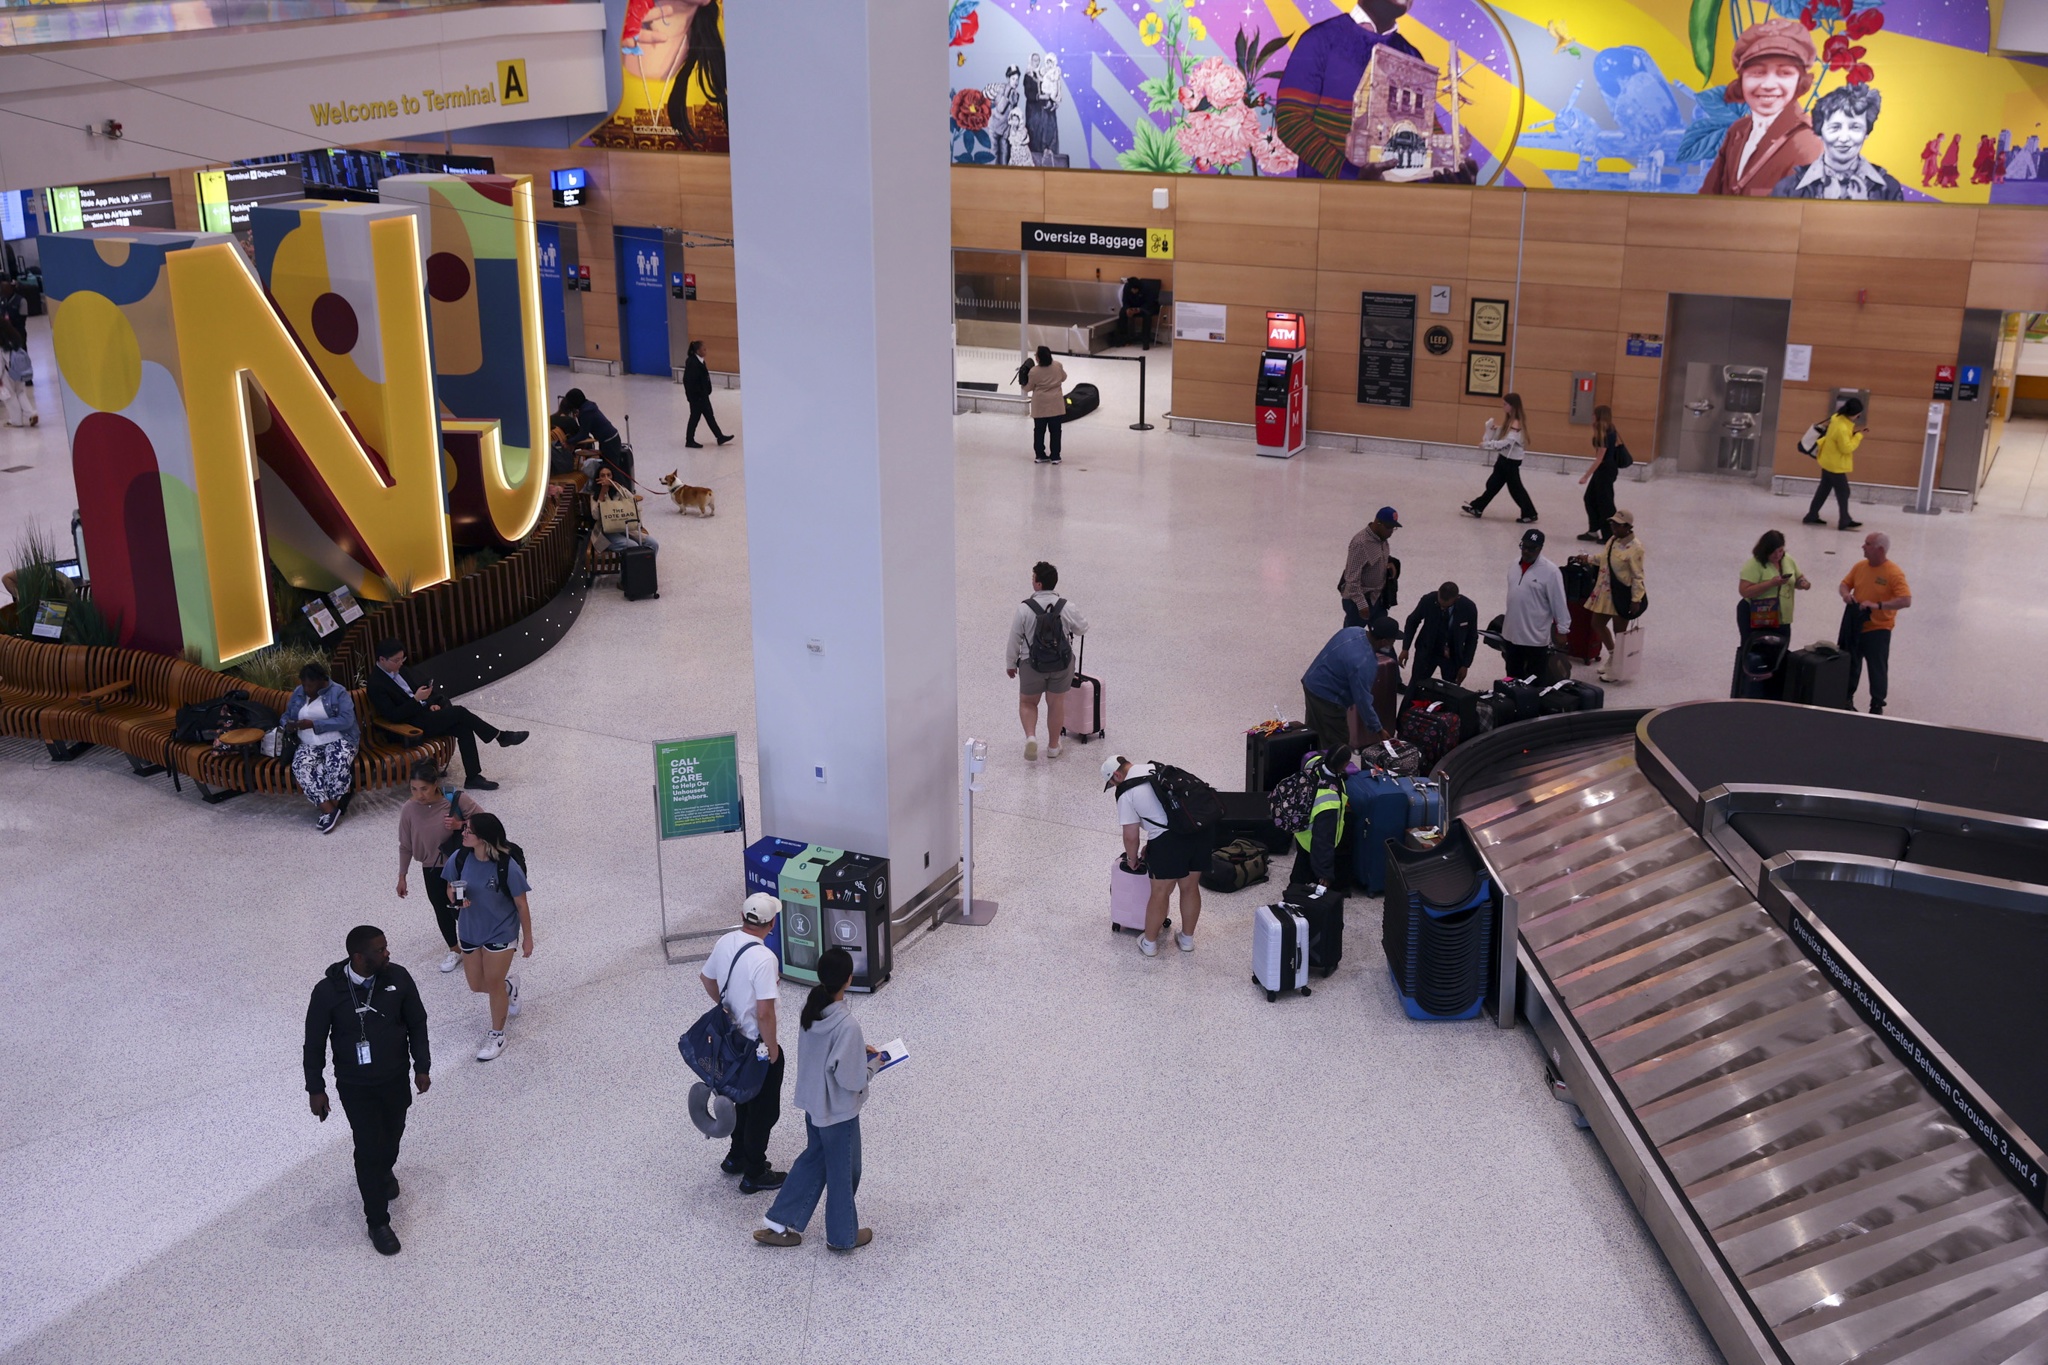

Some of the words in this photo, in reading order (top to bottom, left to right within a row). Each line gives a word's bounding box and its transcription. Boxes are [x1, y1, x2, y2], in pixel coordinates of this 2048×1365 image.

[309, 100, 398, 126] Welcome
[401, 94, 420, 114] to
[422, 82, 496, 112] Terminal
[504, 65, 524, 99] A
[226, 172, 250, 181] Terminal
[80, 189, 95, 198] Taxis
[81, 199, 95, 208] Ride
[95, 198, 108, 207] App
[108, 196, 121, 205] Pick
[121, 195, 130, 204] Up
[83, 213, 104, 222] Shuttle
[232, 214, 249, 223] Rental
[1034, 229, 1086, 244] Oversize
[1090, 233, 1144, 249] Baggage
[1270, 328, 1295, 340] ATM
[1430, 335, 1447, 344] LEED
[670, 757, 700, 767] CALL
[671, 766, 694, 775] FOR
[671, 773, 703, 783] CARE
[672, 787, 706, 795] Unhoused
[673, 793, 708, 802] Neighbors.
[1794, 918, 1821, 955] Oversize
[1822, 948, 1852, 989] Baggage
[1853, 981, 1881, 1021] Pick-Up
[1882, 1013, 1914, 1055] Located
[1914, 1047, 1951, 1096] Between
[1952, 1089, 1998, 1147] Carousels
[2000, 1139, 2007, 1156] 3
[2009, 1152, 2028, 1177] and
[2029, 1172, 2037, 1188] 4
